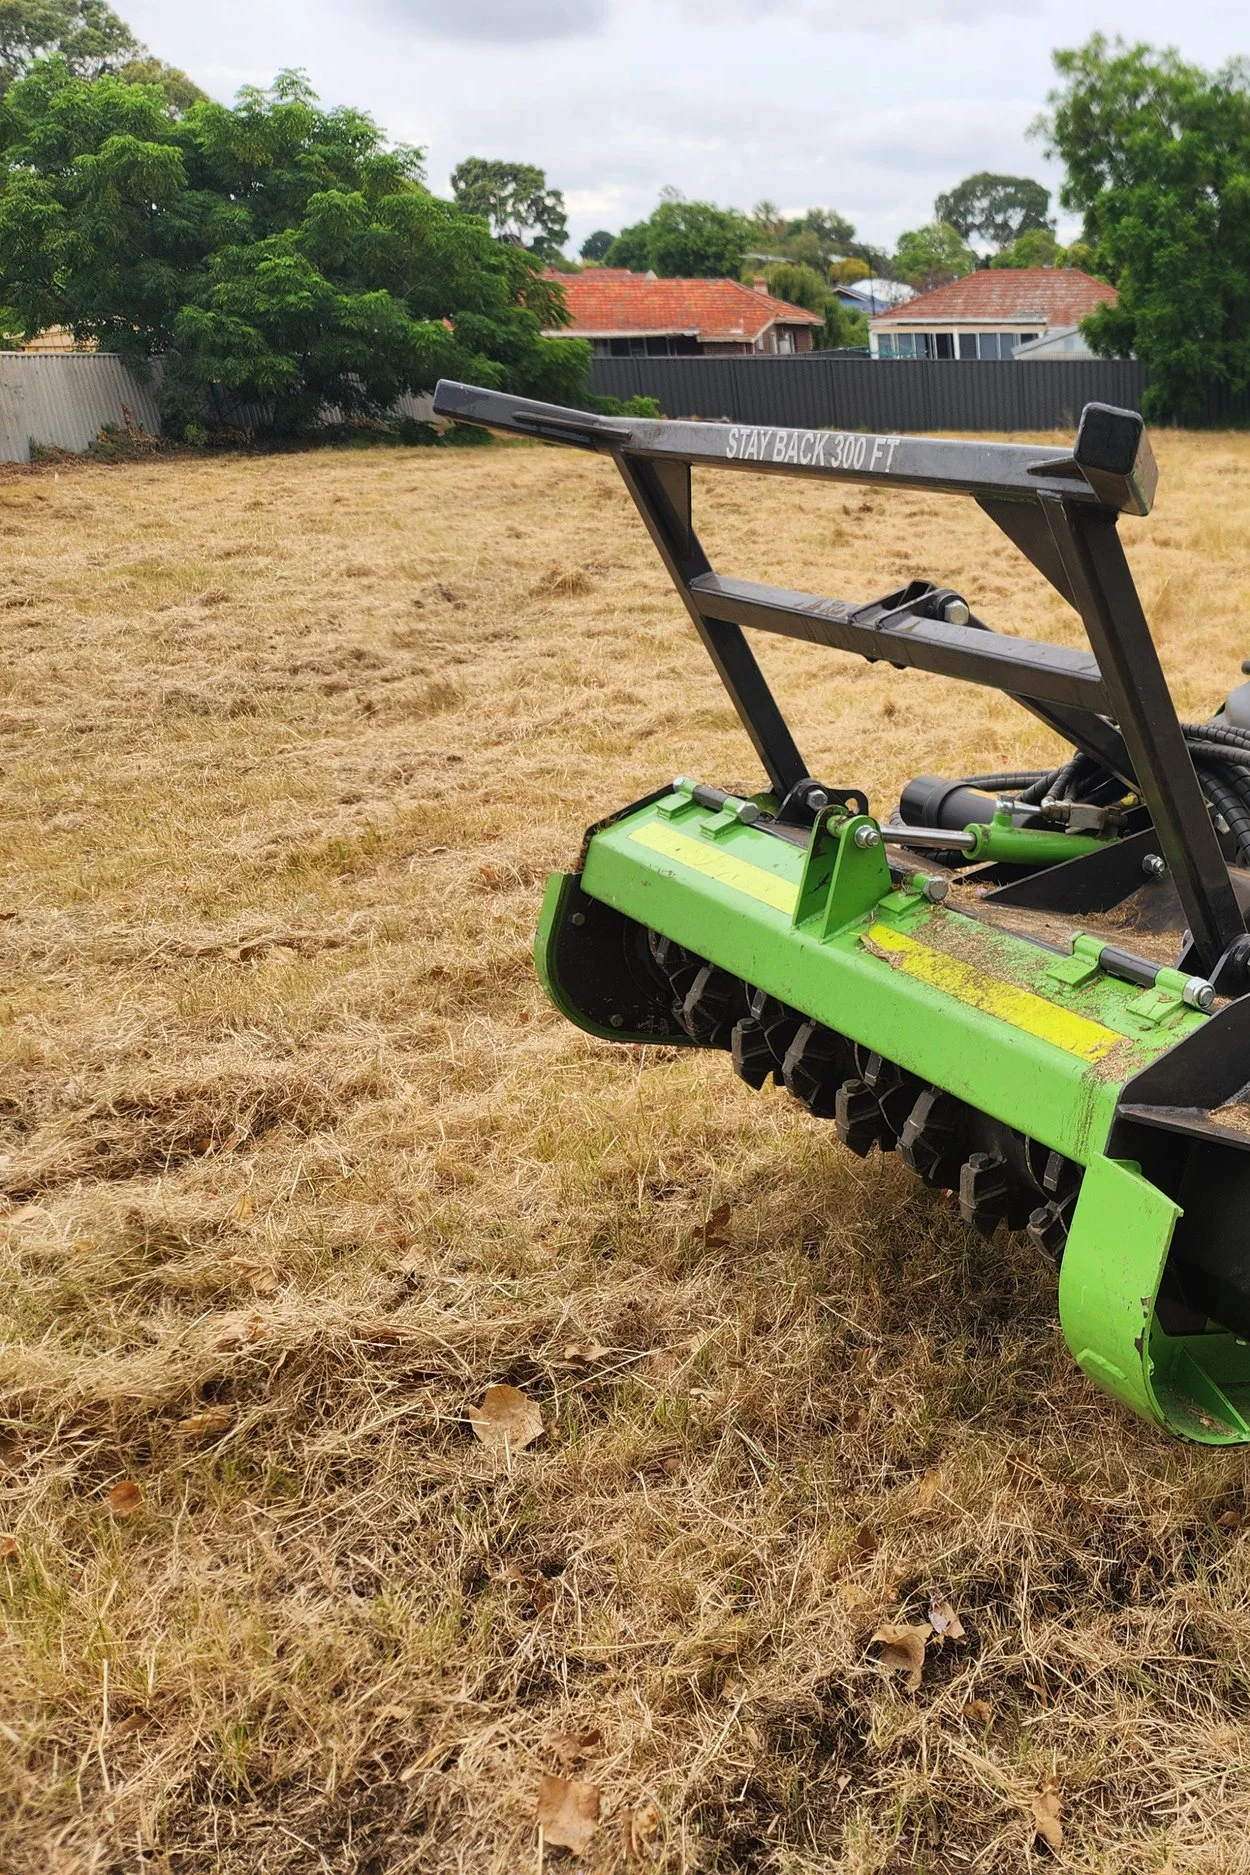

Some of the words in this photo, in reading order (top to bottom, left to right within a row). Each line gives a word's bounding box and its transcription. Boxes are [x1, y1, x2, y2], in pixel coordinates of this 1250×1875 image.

[726, 428, 772, 461] STAY
[772, 431, 830, 466] BACK
[831, 435, 867, 470] 300
[869, 438, 901, 472] FT
